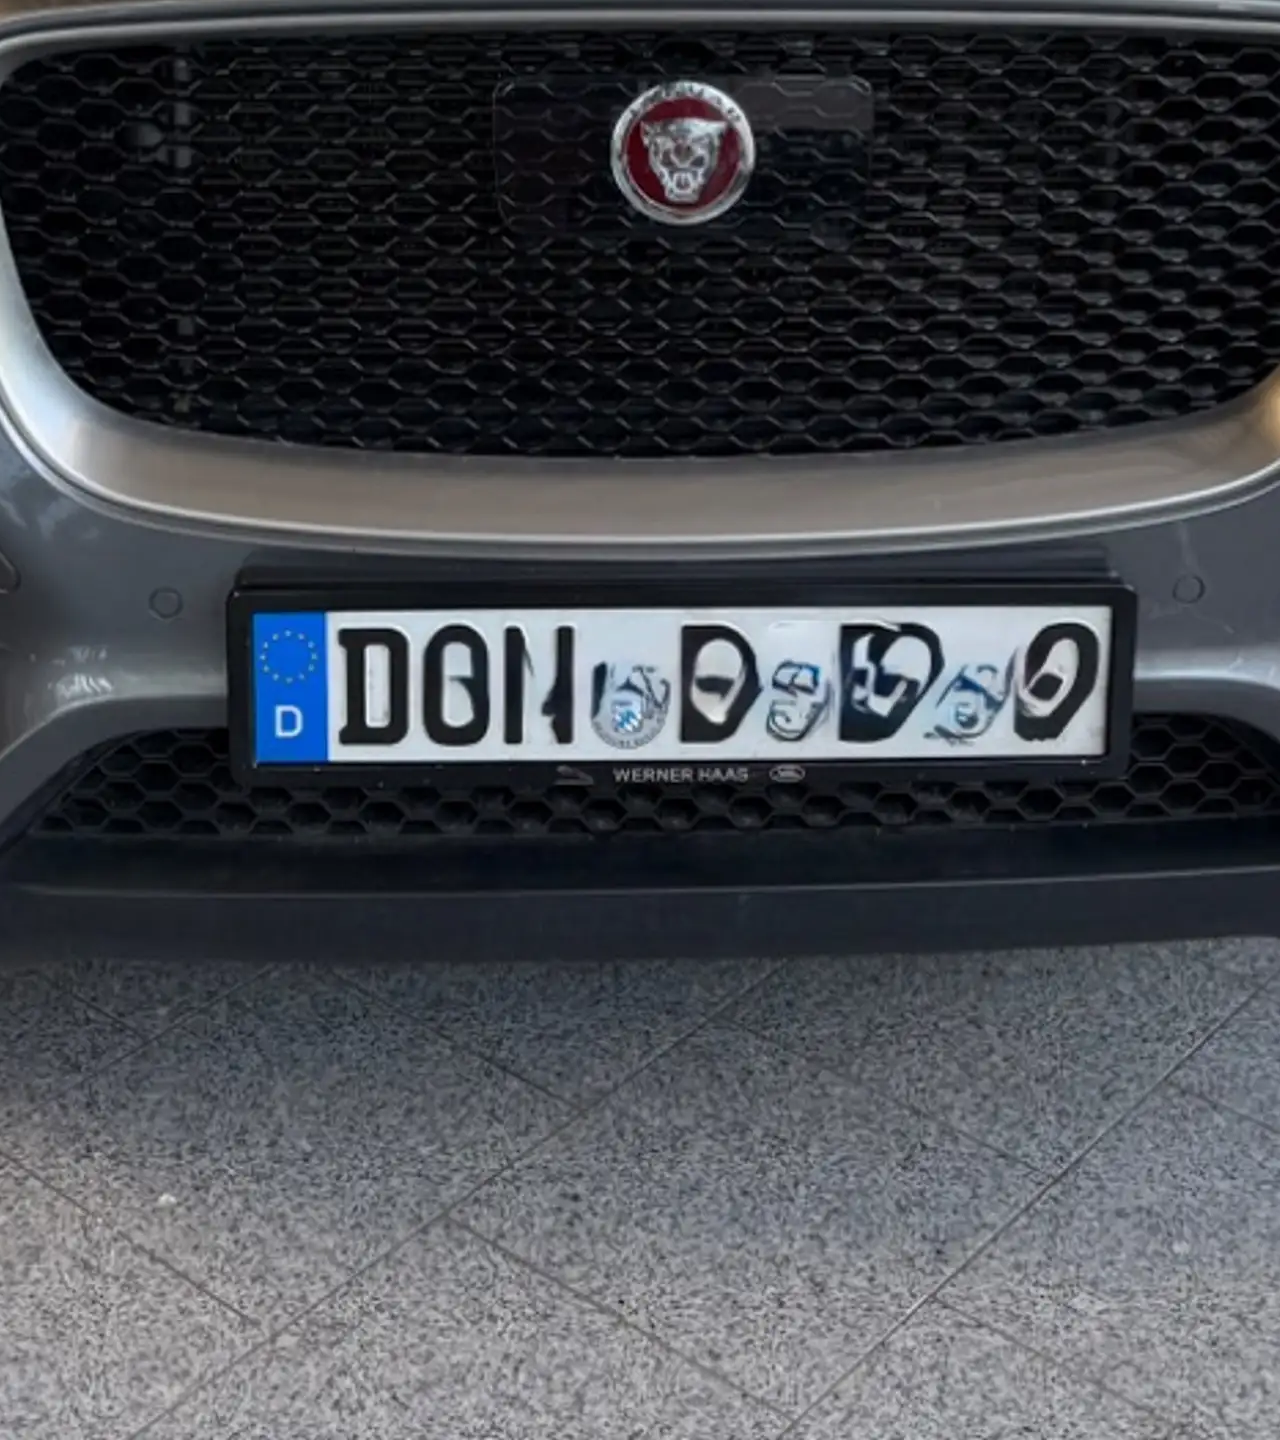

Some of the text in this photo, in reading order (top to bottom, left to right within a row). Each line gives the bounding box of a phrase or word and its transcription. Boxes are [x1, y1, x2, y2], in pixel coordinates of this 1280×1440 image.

[274, 704, 304, 738] D
[612, 766, 749, 783] WERNER HAAS
